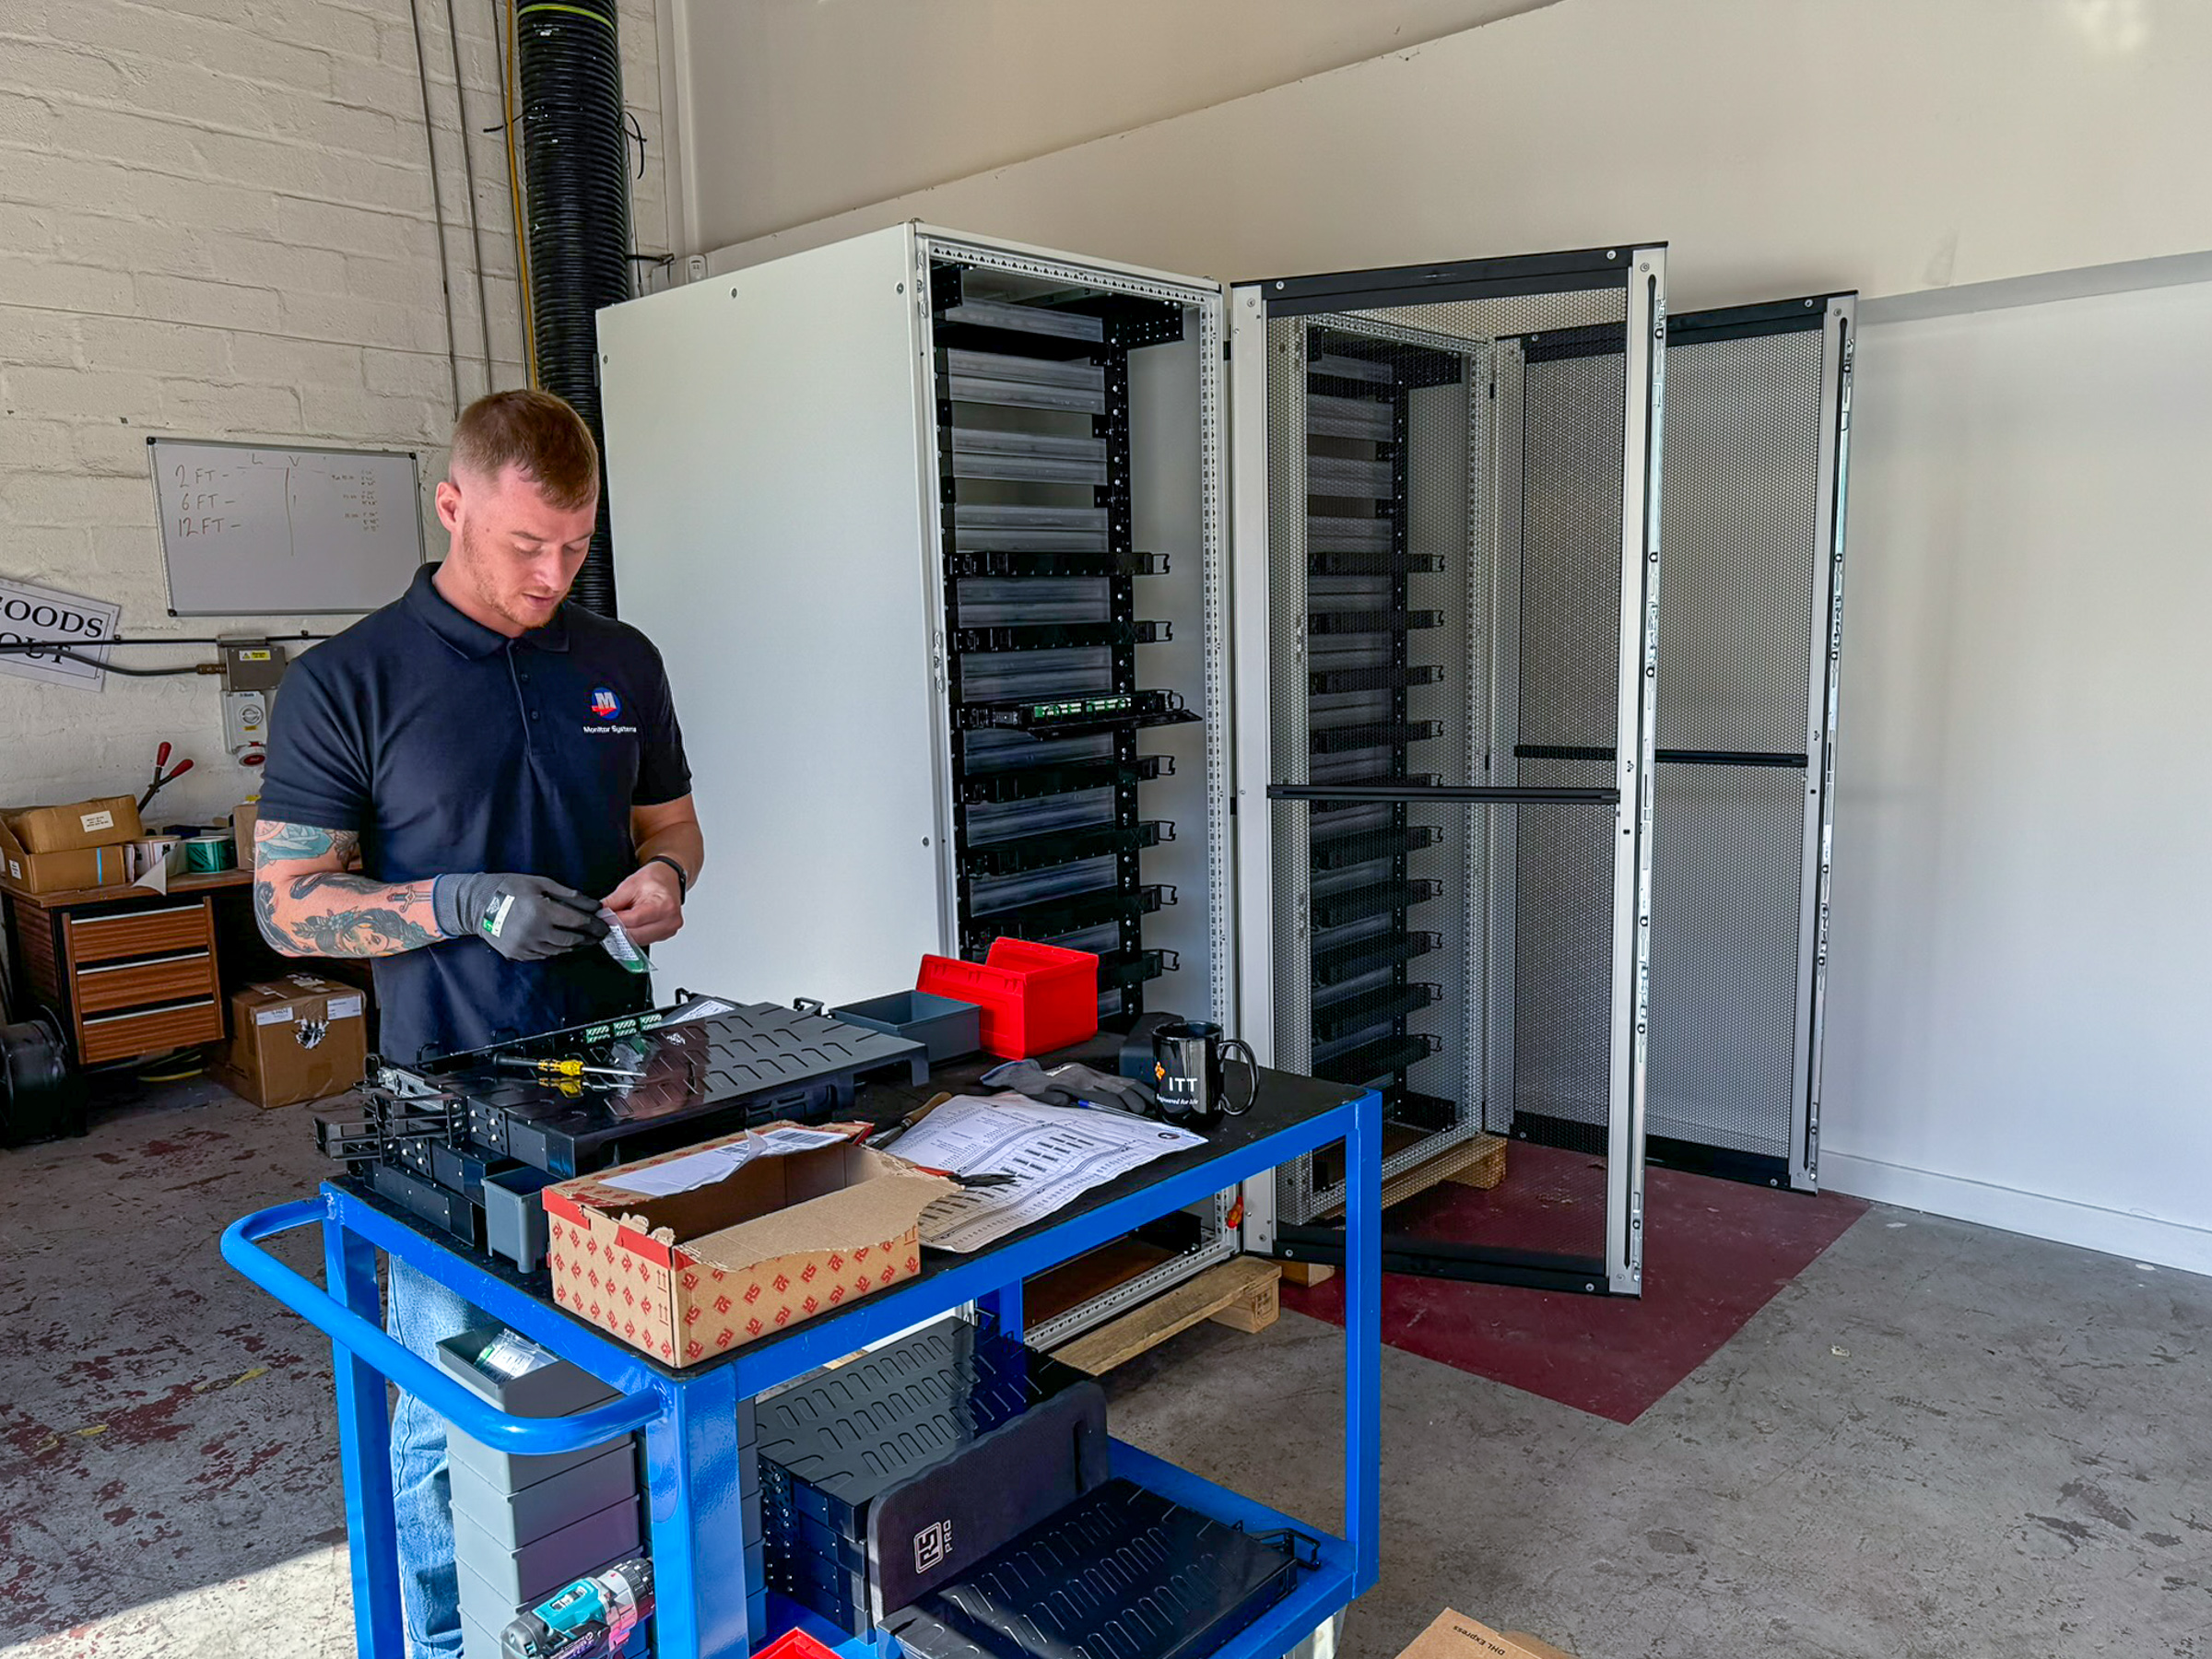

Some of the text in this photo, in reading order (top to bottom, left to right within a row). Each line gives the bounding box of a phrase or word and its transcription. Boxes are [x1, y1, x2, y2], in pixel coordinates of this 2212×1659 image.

[175, 465, 190, 488] 2
[195, 468, 216, 484] FT
[182, 493, 190, 511] 6
[197, 494, 218, 510] FT
[0, 595, 103, 639] OODS
[582, 724, 637, 735] Monitor Systems
[1169, 1077, 1198, 1092] ITT
[828, 1254, 844, 1272] RS
[682, 1272, 699, 1290] RS
[772, 1274, 790, 1292] RS
[801, 1264, 817, 1283] RS
[881, 1265, 895, 1283] RS
[743, 1283, 760, 1304] RS
[855, 1276, 871, 1292] RS
[830, 1285, 845, 1304] RS
[713, 1295, 732, 1314] RS
[803, 1296, 818, 1313] RS
[684, 1305, 700, 1325] RS
[775, 1306, 791, 1325] RS
[746, 1317, 763, 1336] RS
[716, 1328, 735, 1347] RS
[686, 1339, 704, 1359] RS
[943, 1519, 953, 1554] PRO
[916, 1525, 940, 1571] RS
[1453, 1625, 1506, 1656] DHL Express
